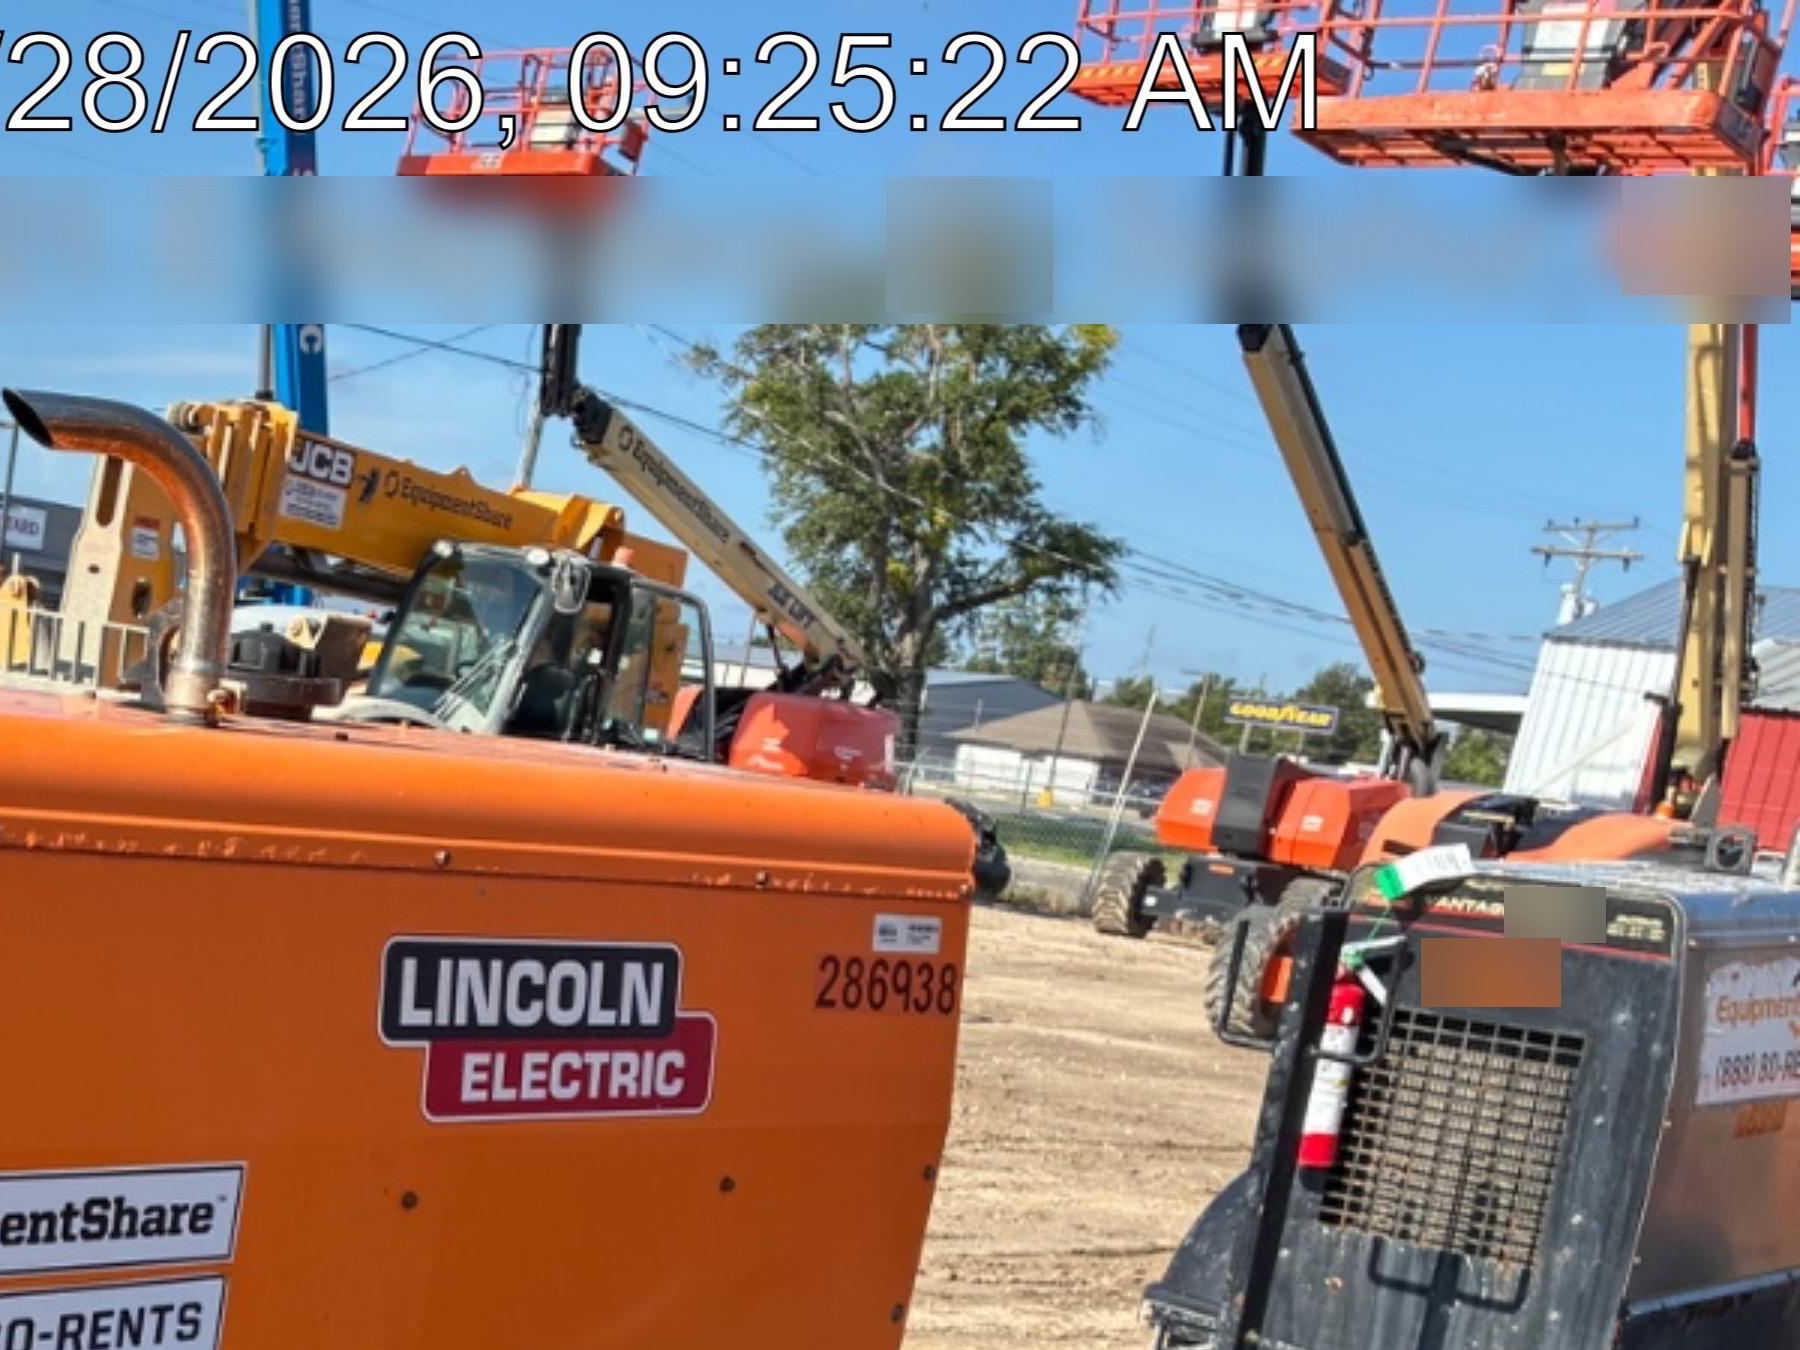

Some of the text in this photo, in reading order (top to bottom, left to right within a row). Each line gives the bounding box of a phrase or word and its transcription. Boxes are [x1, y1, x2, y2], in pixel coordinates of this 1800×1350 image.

[290, 439, 355, 482] JCB
[401, 476, 513, 530] EquipmentShare
[1229, 702, 1332, 727] GOODYEAR
[398, 956, 665, 1028] LINCOLN
[814, 954, 958, 1016] 286938
[459, 1050, 686, 1102] ELECTRIC
